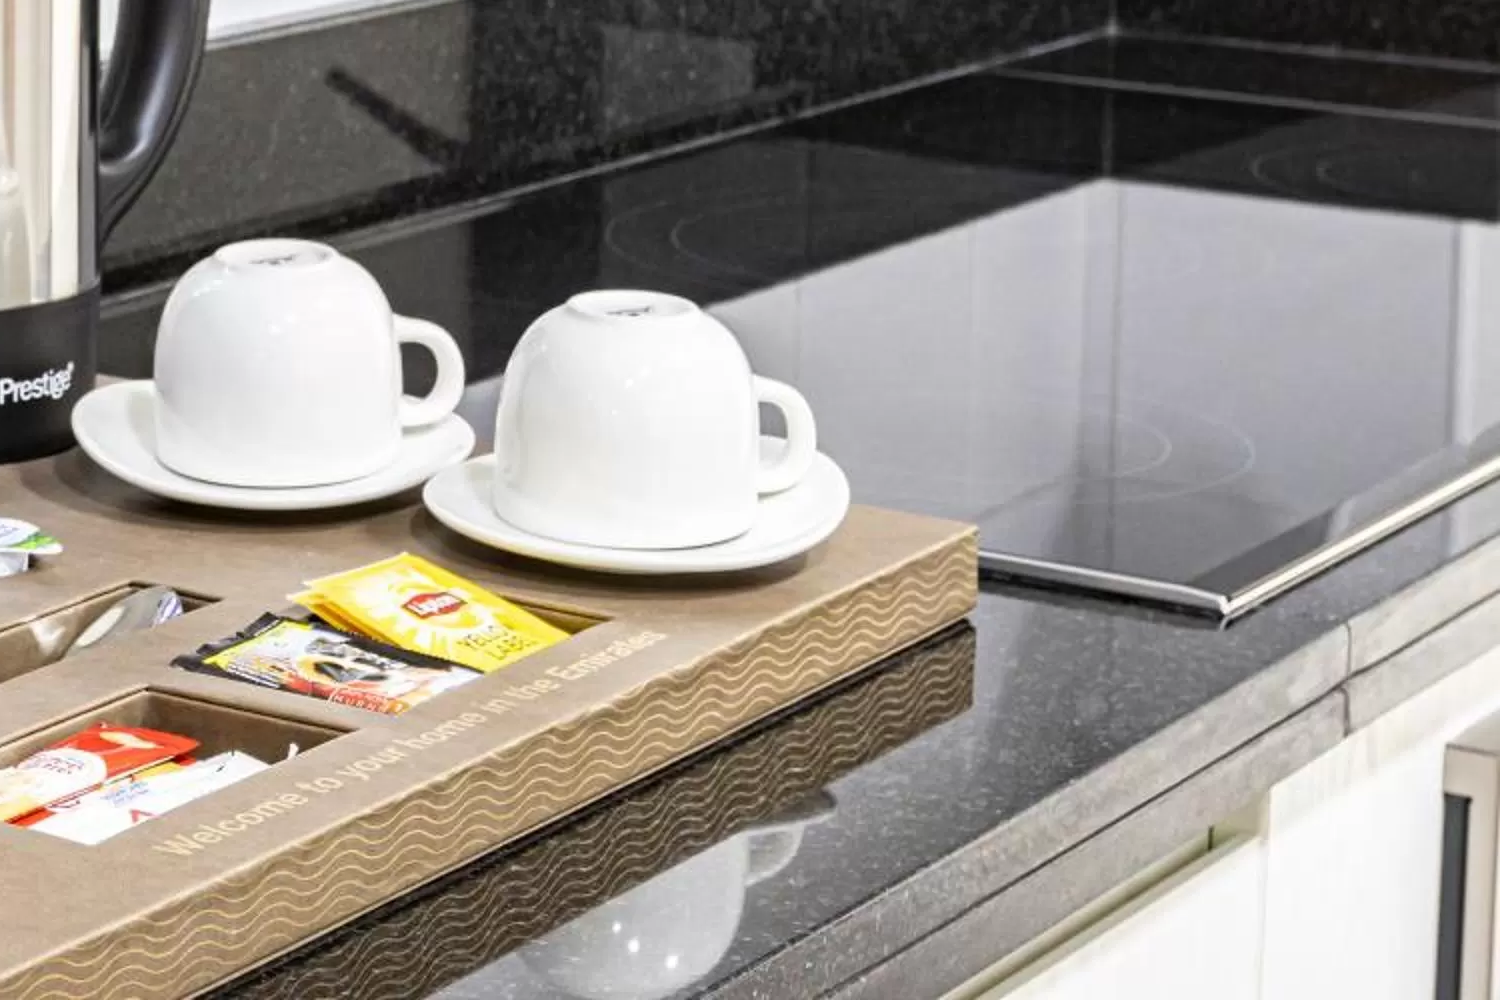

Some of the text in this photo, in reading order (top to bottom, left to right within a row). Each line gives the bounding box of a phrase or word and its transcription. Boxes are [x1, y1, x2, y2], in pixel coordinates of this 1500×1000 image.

[152, 791, 309, 856] Welcome
[295, 776, 344, 794] to
[337, 746, 407, 782] your
[392, 711, 487, 750] home
[503, 678, 560, 700] the
[544, 631, 667, 681] Emirates
